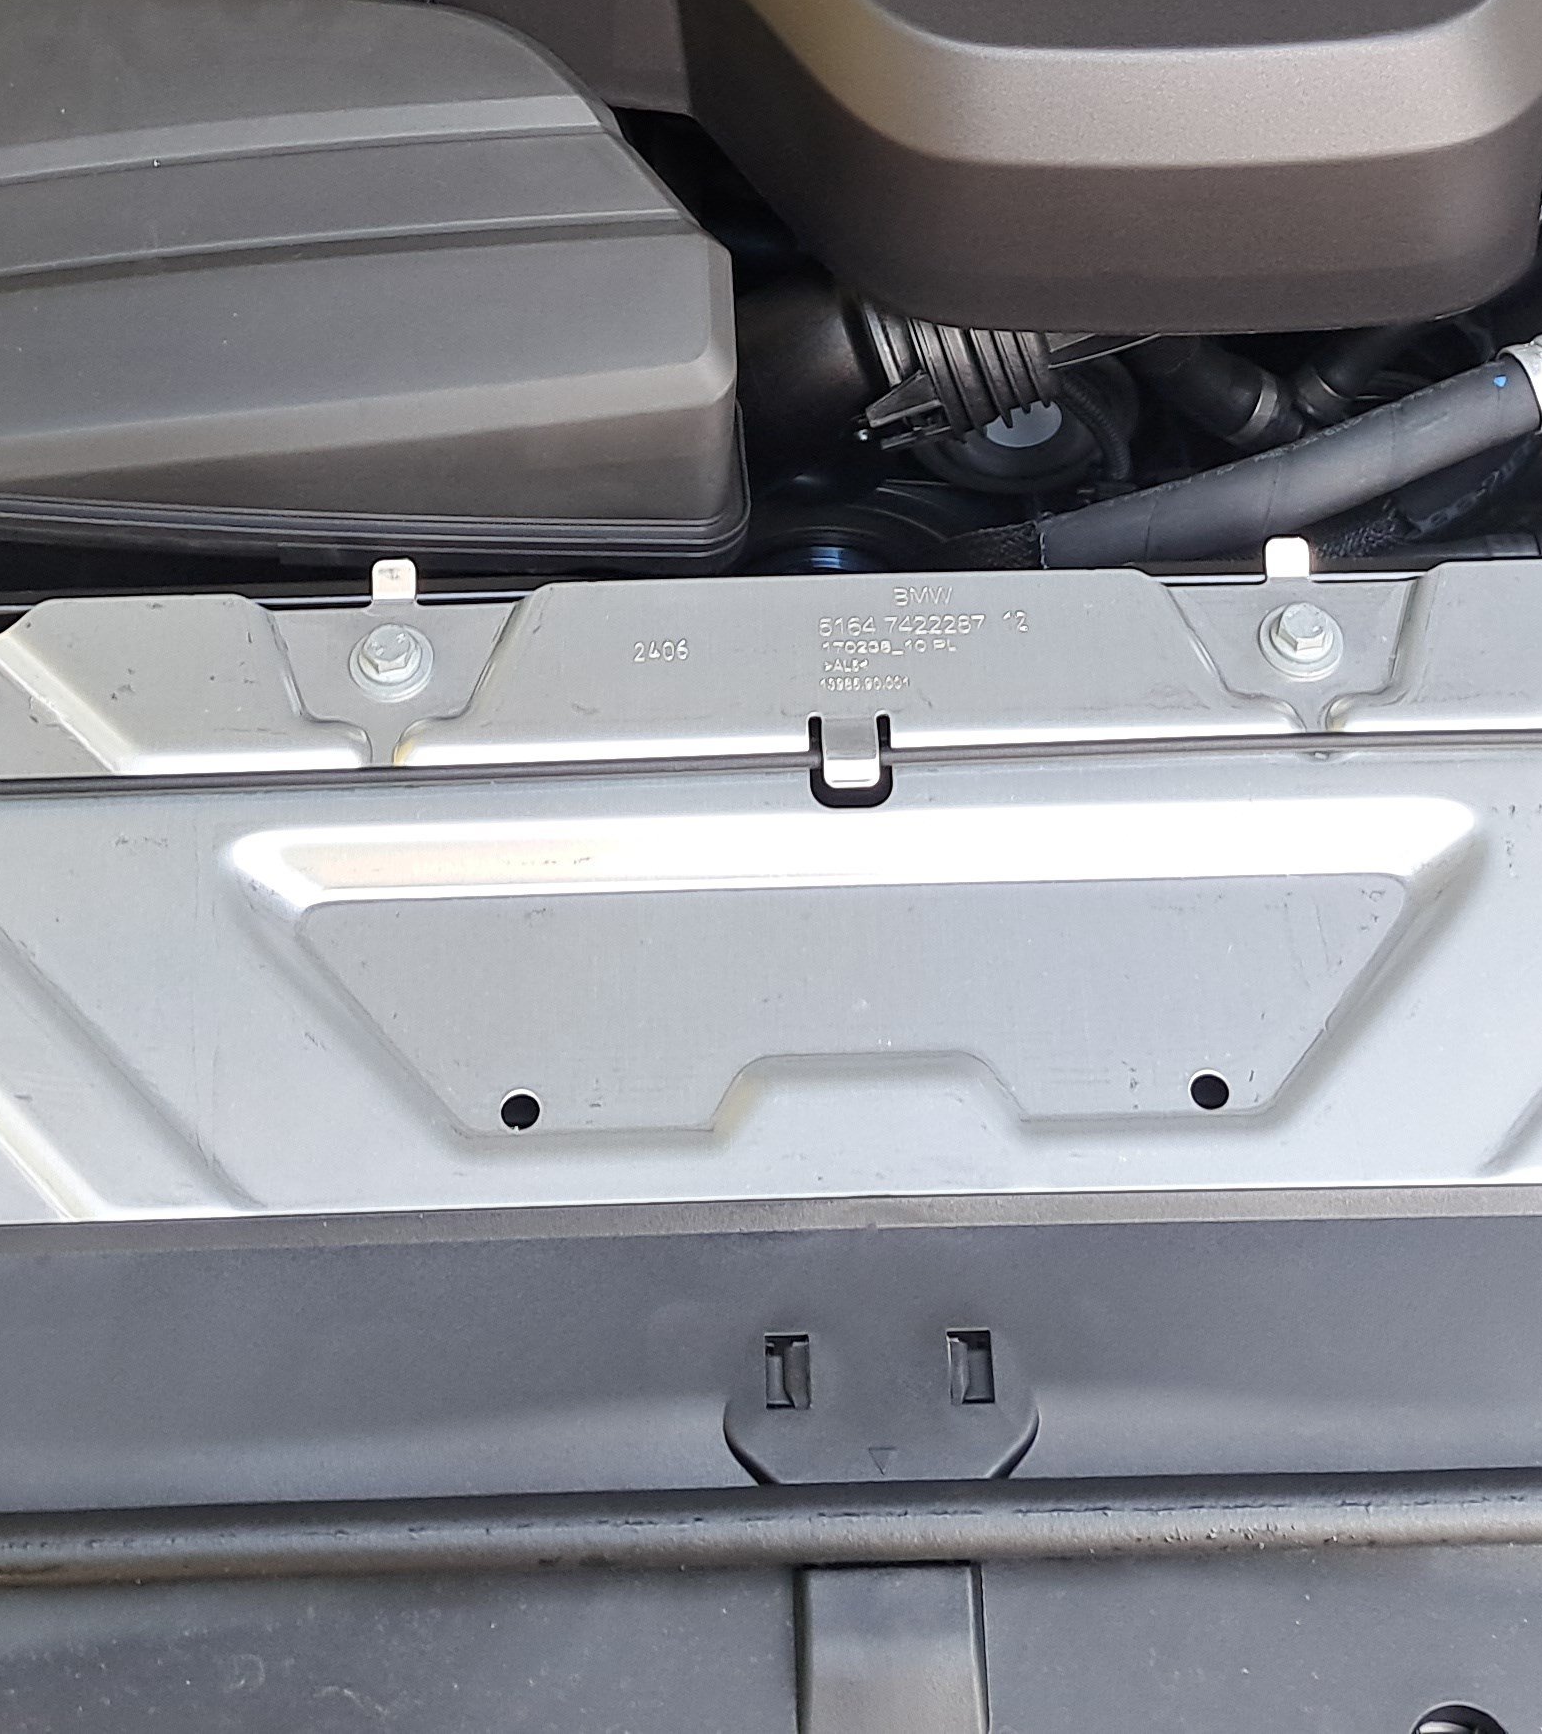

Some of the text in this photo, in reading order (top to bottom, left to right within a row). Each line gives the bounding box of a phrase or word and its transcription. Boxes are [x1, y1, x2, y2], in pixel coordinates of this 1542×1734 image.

[893, 586, 953, 607] BMW
[883, 614, 986, 635] 7422287
[633, 639, 689, 663] 2406
